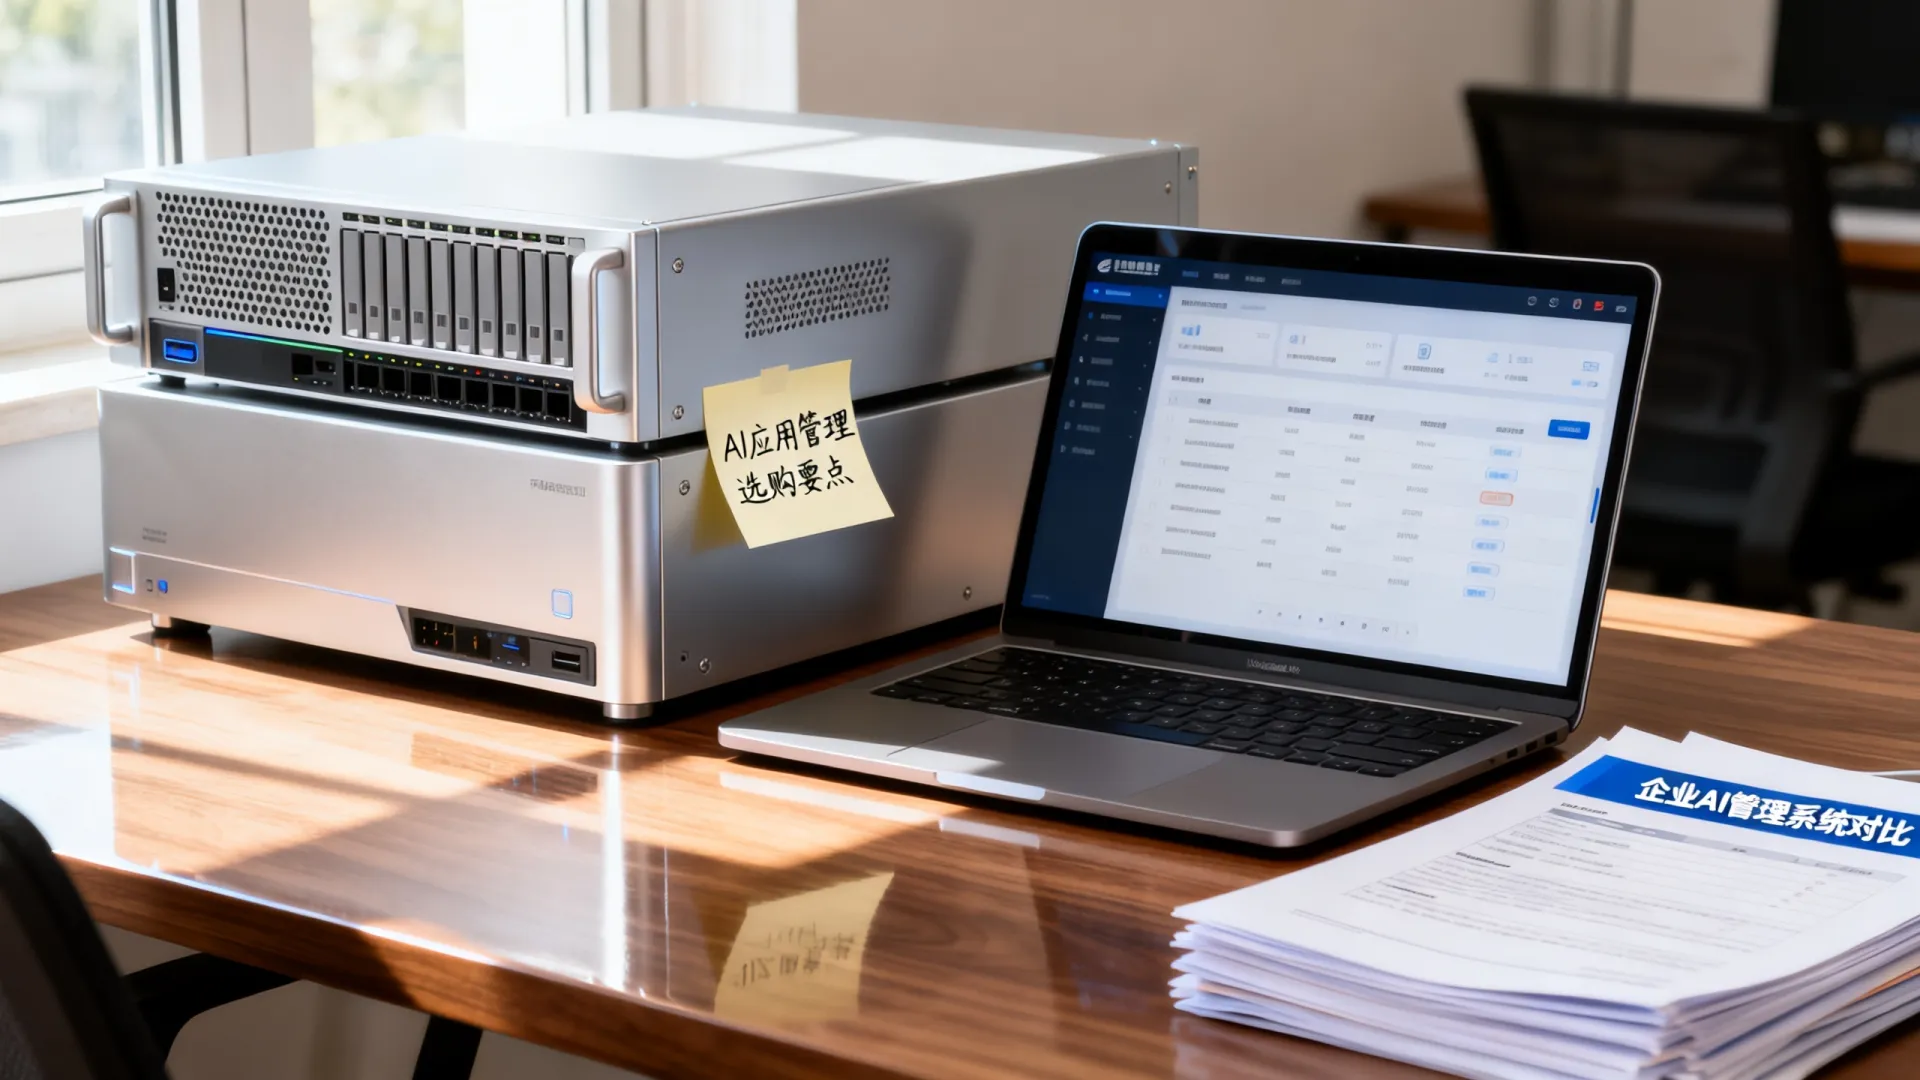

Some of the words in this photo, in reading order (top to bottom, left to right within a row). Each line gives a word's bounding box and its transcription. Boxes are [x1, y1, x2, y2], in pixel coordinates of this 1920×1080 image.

[724, 409, 856, 462] AI应用管理
[736, 455, 855, 504] 选购要点
[1636, 777, 1915, 848] 企业AI管理系统对比
